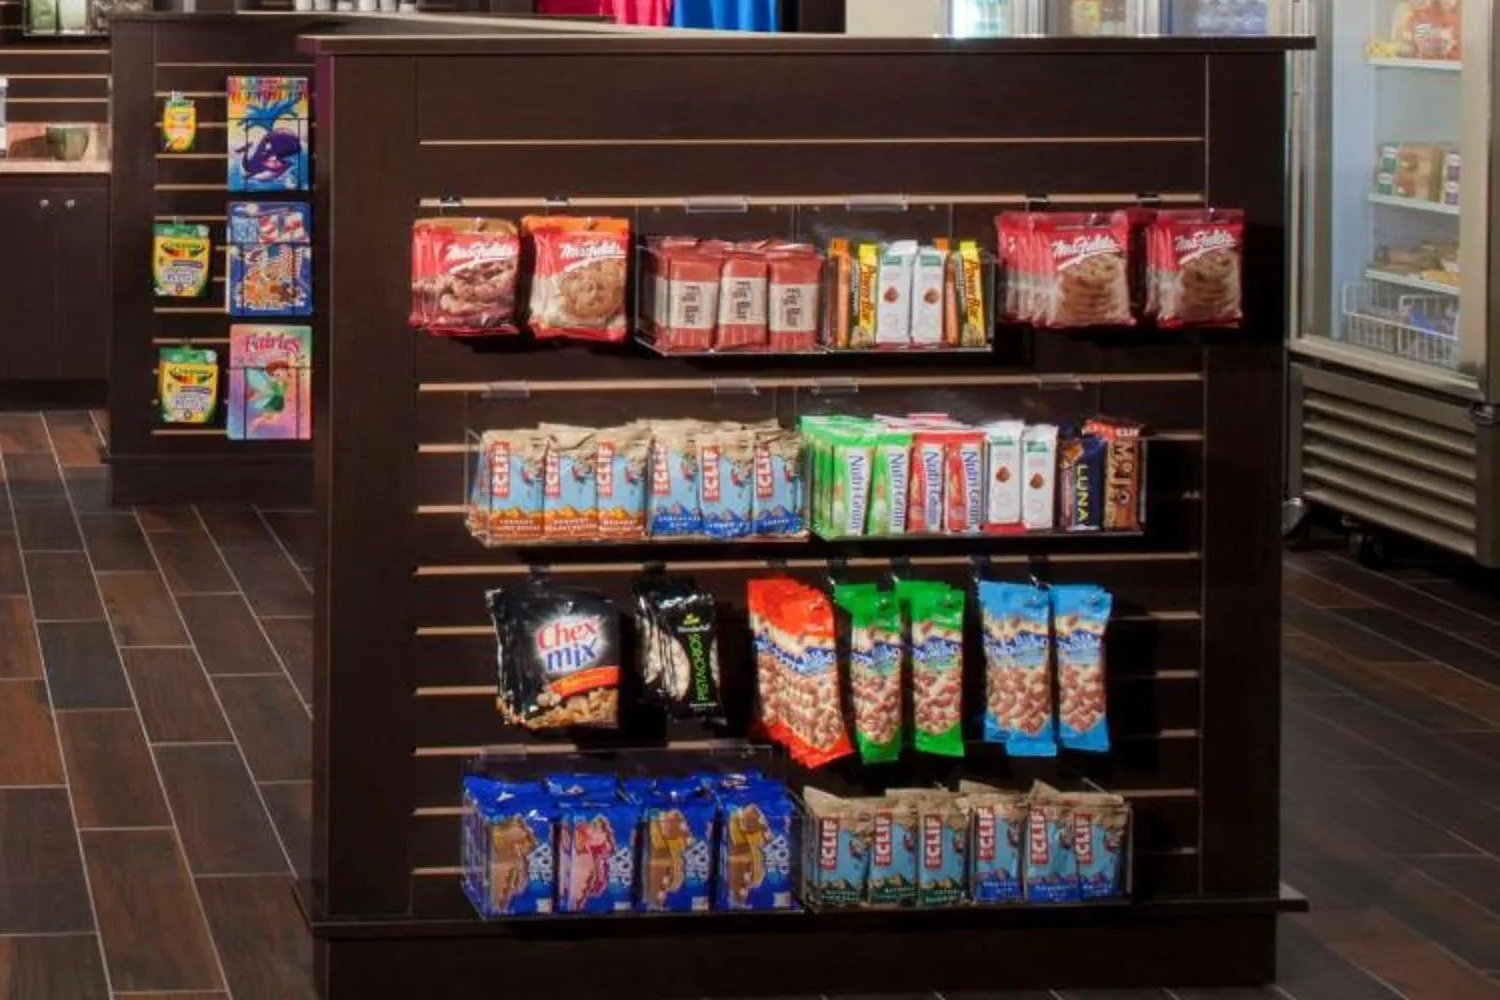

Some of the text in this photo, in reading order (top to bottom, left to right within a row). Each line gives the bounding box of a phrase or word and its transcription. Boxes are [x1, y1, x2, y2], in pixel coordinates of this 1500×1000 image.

[684, 305, 699, 325] Bar
[736, 301, 750, 319] Bar
[786, 307, 801, 327] Bar
[1075, 464, 1090, 522] LUNA
[536, 620, 598, 650] Chex
[546, 637, 597, 671] mix
